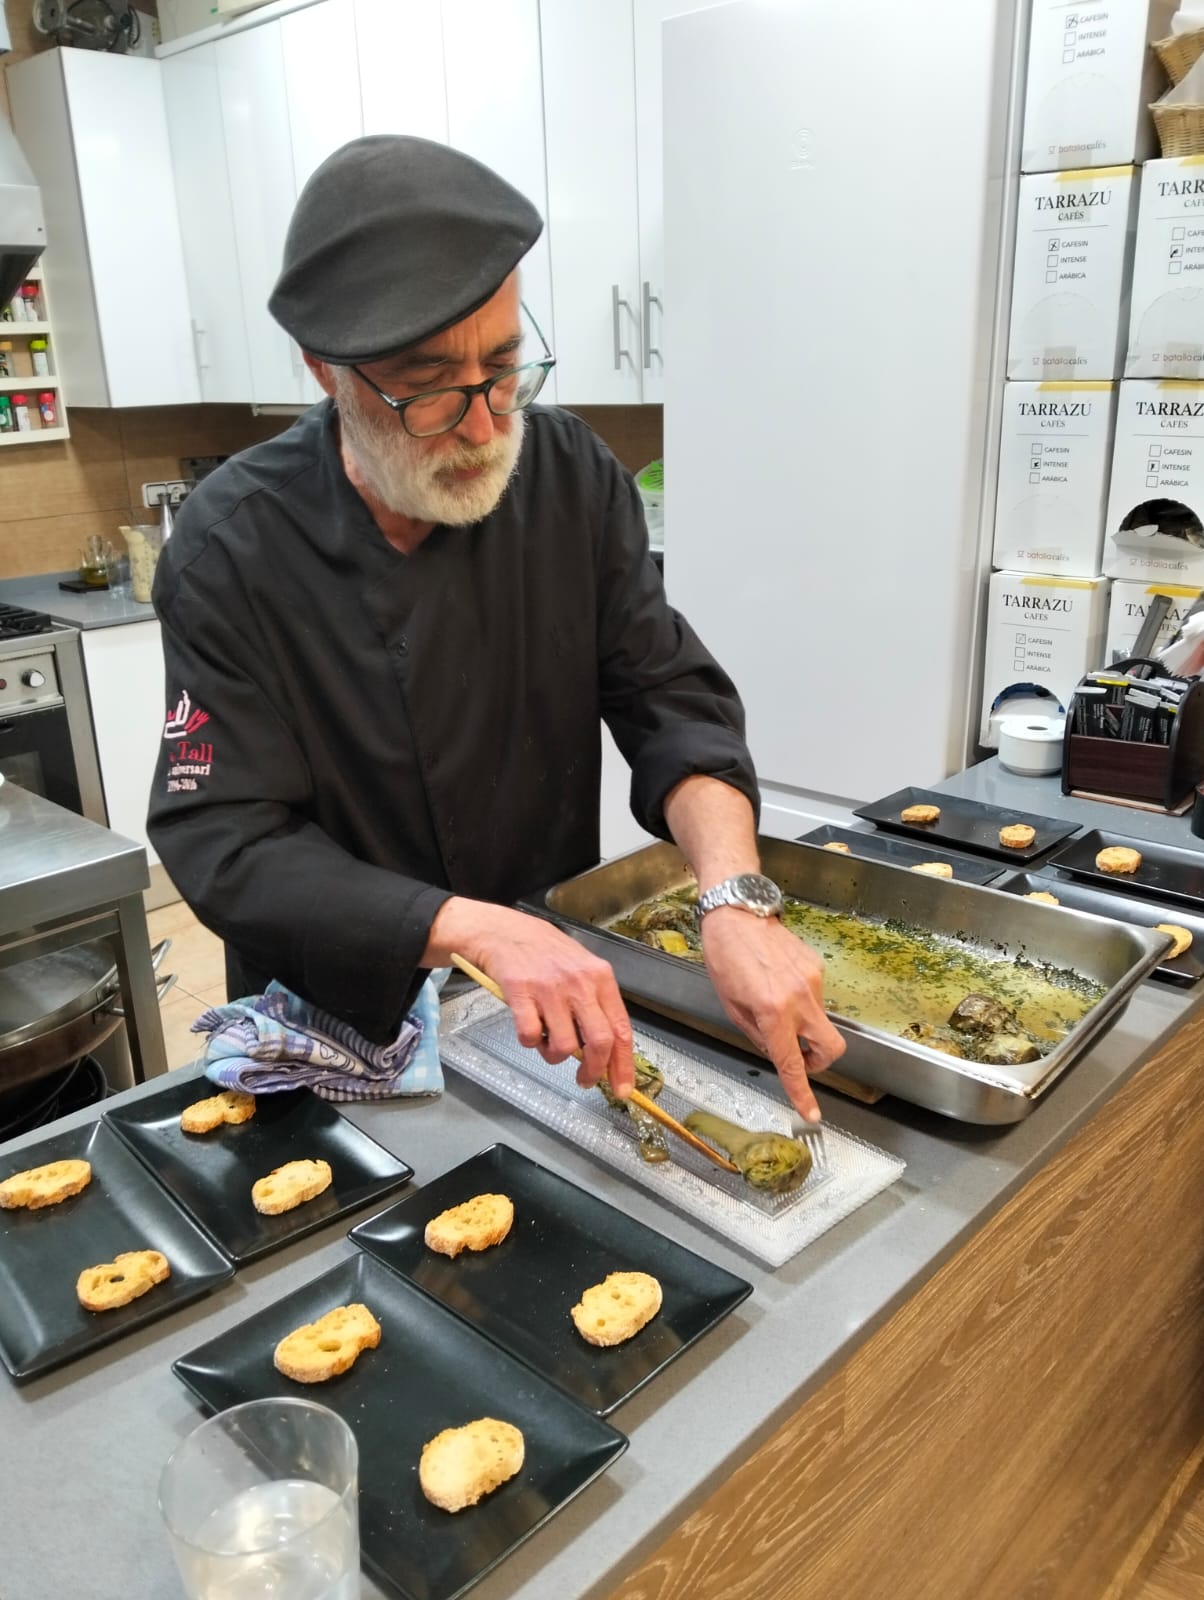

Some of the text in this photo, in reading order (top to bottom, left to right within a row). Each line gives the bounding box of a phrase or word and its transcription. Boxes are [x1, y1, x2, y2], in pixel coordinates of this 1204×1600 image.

[1078, 30, 1106, 40] INTENSE
[1061, 240, 1088, 248] CAFESIN
[1060, 256, 1088, 264] INTENSE
[1044, 446, 1070, 454] CAFESIN
[1164, 448, 1192, 456] CAFESIN
[1162, 464, 1190, 472] INTENSE
[1028, 638, 1052, 646] CAFESIN
[1027, 651, 1051, 659] INTENSE
[177, 742, 213, 764] Tall
